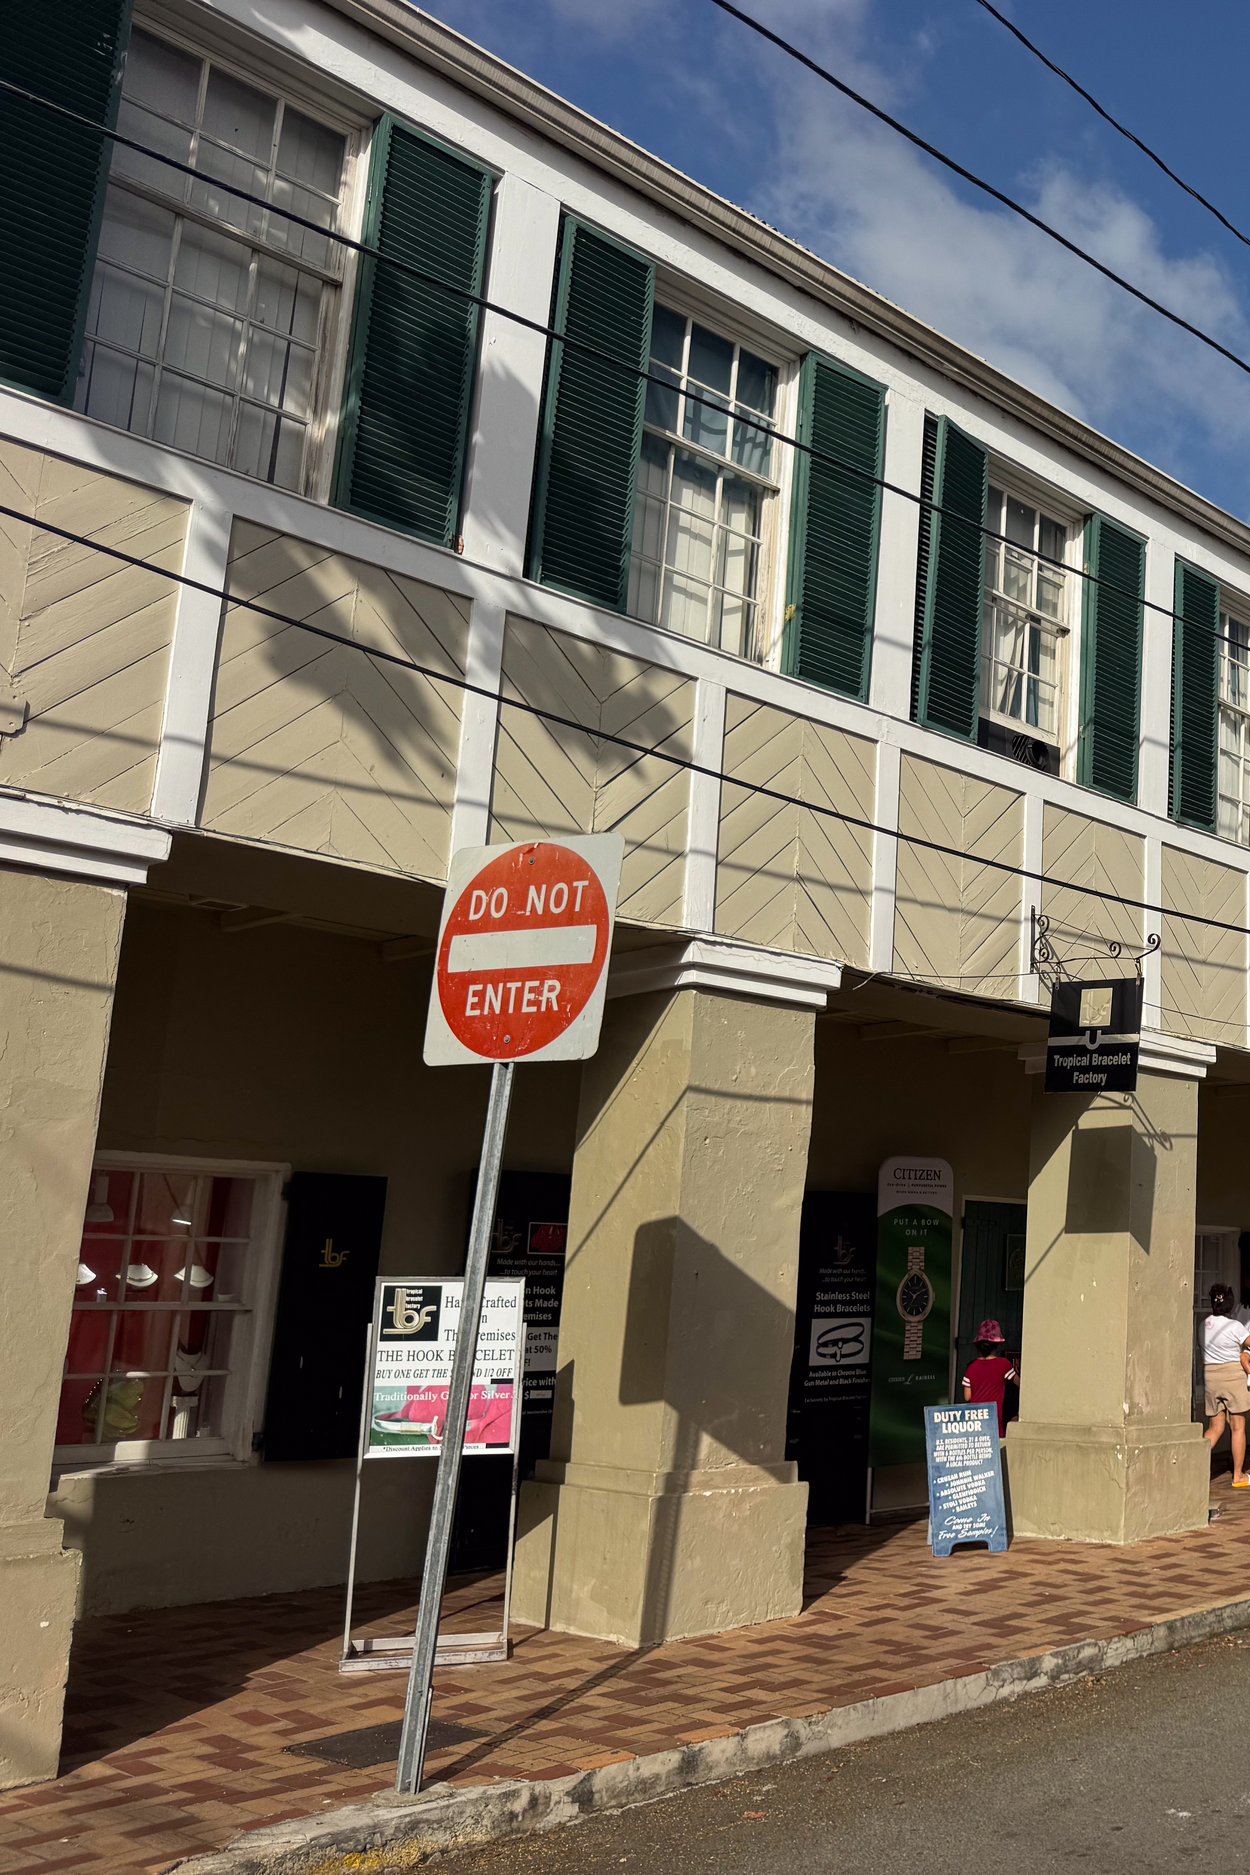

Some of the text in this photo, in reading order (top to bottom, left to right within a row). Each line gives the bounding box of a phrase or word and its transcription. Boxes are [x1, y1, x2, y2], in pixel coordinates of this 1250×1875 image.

[469, 880, 590, 921] DO NOT
[465, 979, 562, 1017] ENTER
[1053, 1052, 1131, 1069] Tropical Bracelet
[1073, 1071, 1107, 1086] Factory
[893, 1168, 942, 1181] CITIZEN
[893, 1218, 909, 1226] PUT
[533, 1286, 556, 1295] Hook
[815, 1291, 870, 1301] Stainless Steel
[534, 1299, 559, 1308] Made
[814, 1303, 871, 1313] Hook Bracelets
[527, 1332, 542, 1341] Get
[534, 1345, 552, 1354] 50%
[377, 1349, 515, 1362] THE HOOK BCELET
[376, 1370, 393, 1379] BUY
[394, 1369, 412, 1379] ONE
[413, 1369, 430, 1379] GET
[431, 1368, 449, 1378] THE
[484, 1368, 495, 1378] 1/2
[496, 1368, 513, 1377] OFF
[375, 1392, 440, 1403] Traditionally
[480, 1390, 511, 1400] Silver
[934, 1408, 990, 1424] DUTY FREE
[942, 1421, 982, 1434] LIQUOR
[958, 1470, 972, 1479] RUM
[973, 1470, 995, 1480] WALKER
[966, 1479, 986, 1489] VODKA
[958, 1495, 978, 1505] VODKA
[944, 1513, 991, 1526] Come In
[938, 1525, 999, 1540] Free Samples!
